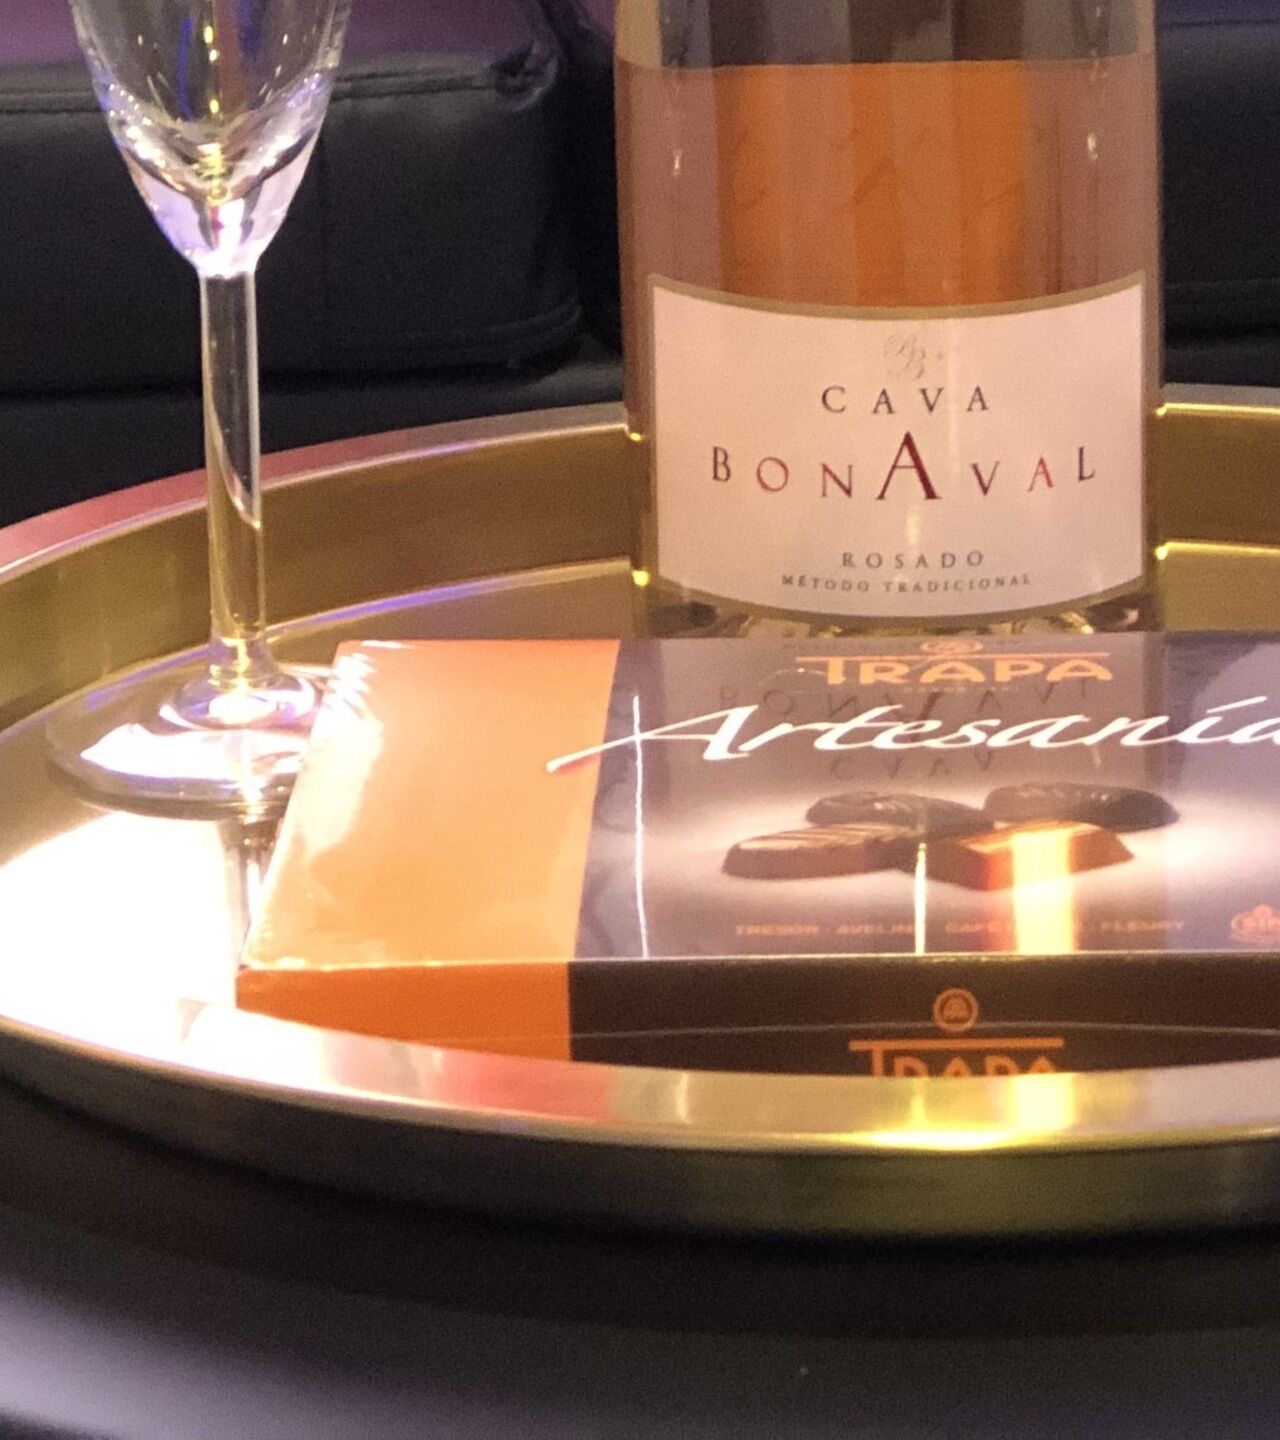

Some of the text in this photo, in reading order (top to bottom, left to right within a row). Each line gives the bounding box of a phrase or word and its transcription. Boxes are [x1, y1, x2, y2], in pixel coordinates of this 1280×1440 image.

[821, 385, 991, 416] CAVA
[711, 430, 1096, 501] BONAVAL
[841, 549, 985, 570] ROSADO
[781, 572, 1032, 594] MÉTODO TRADICIONAL
[794, 651, 1114, 686] TRAPA
